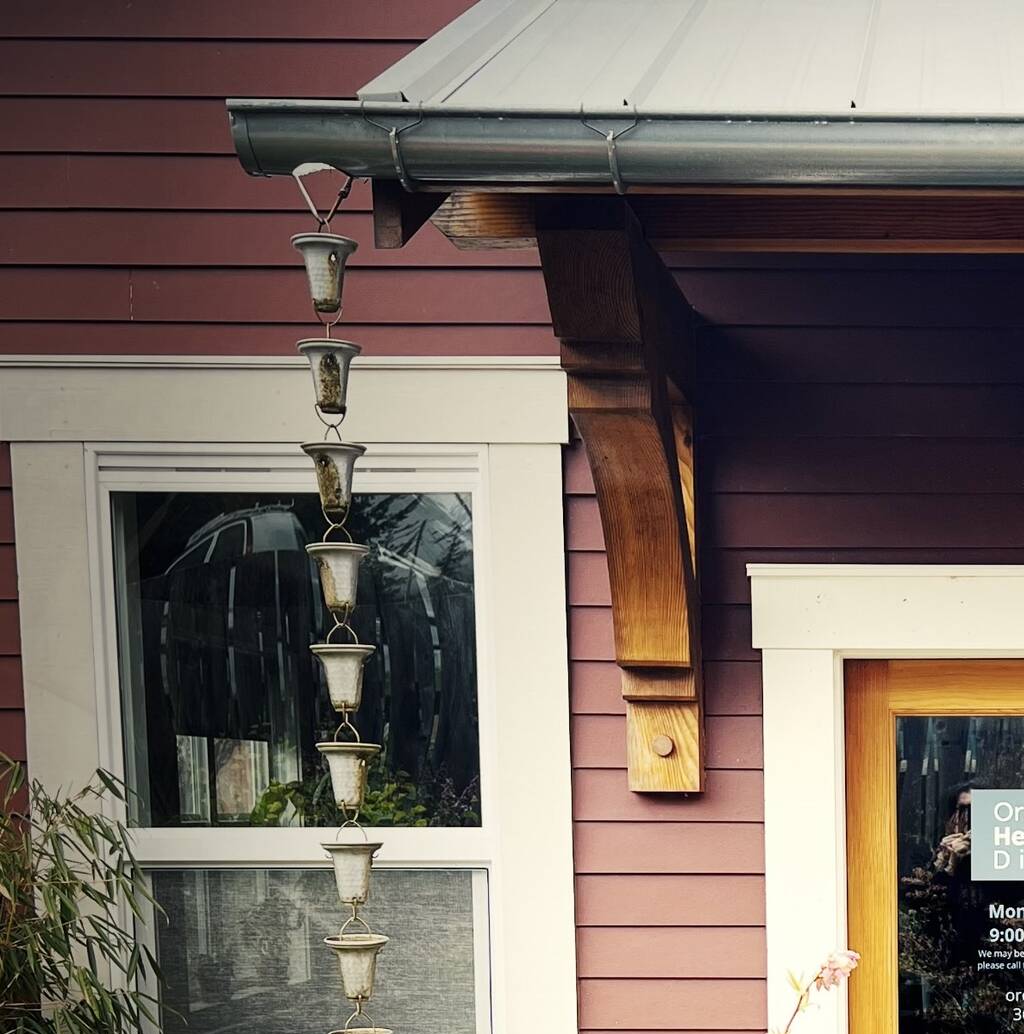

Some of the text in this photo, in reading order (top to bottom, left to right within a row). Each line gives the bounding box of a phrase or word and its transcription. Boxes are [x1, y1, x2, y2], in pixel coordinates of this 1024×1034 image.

[990, 928, 1024, 942] 9:00
[994, 951, 1012, 960] may
[978, 962, 1004, 971] please
